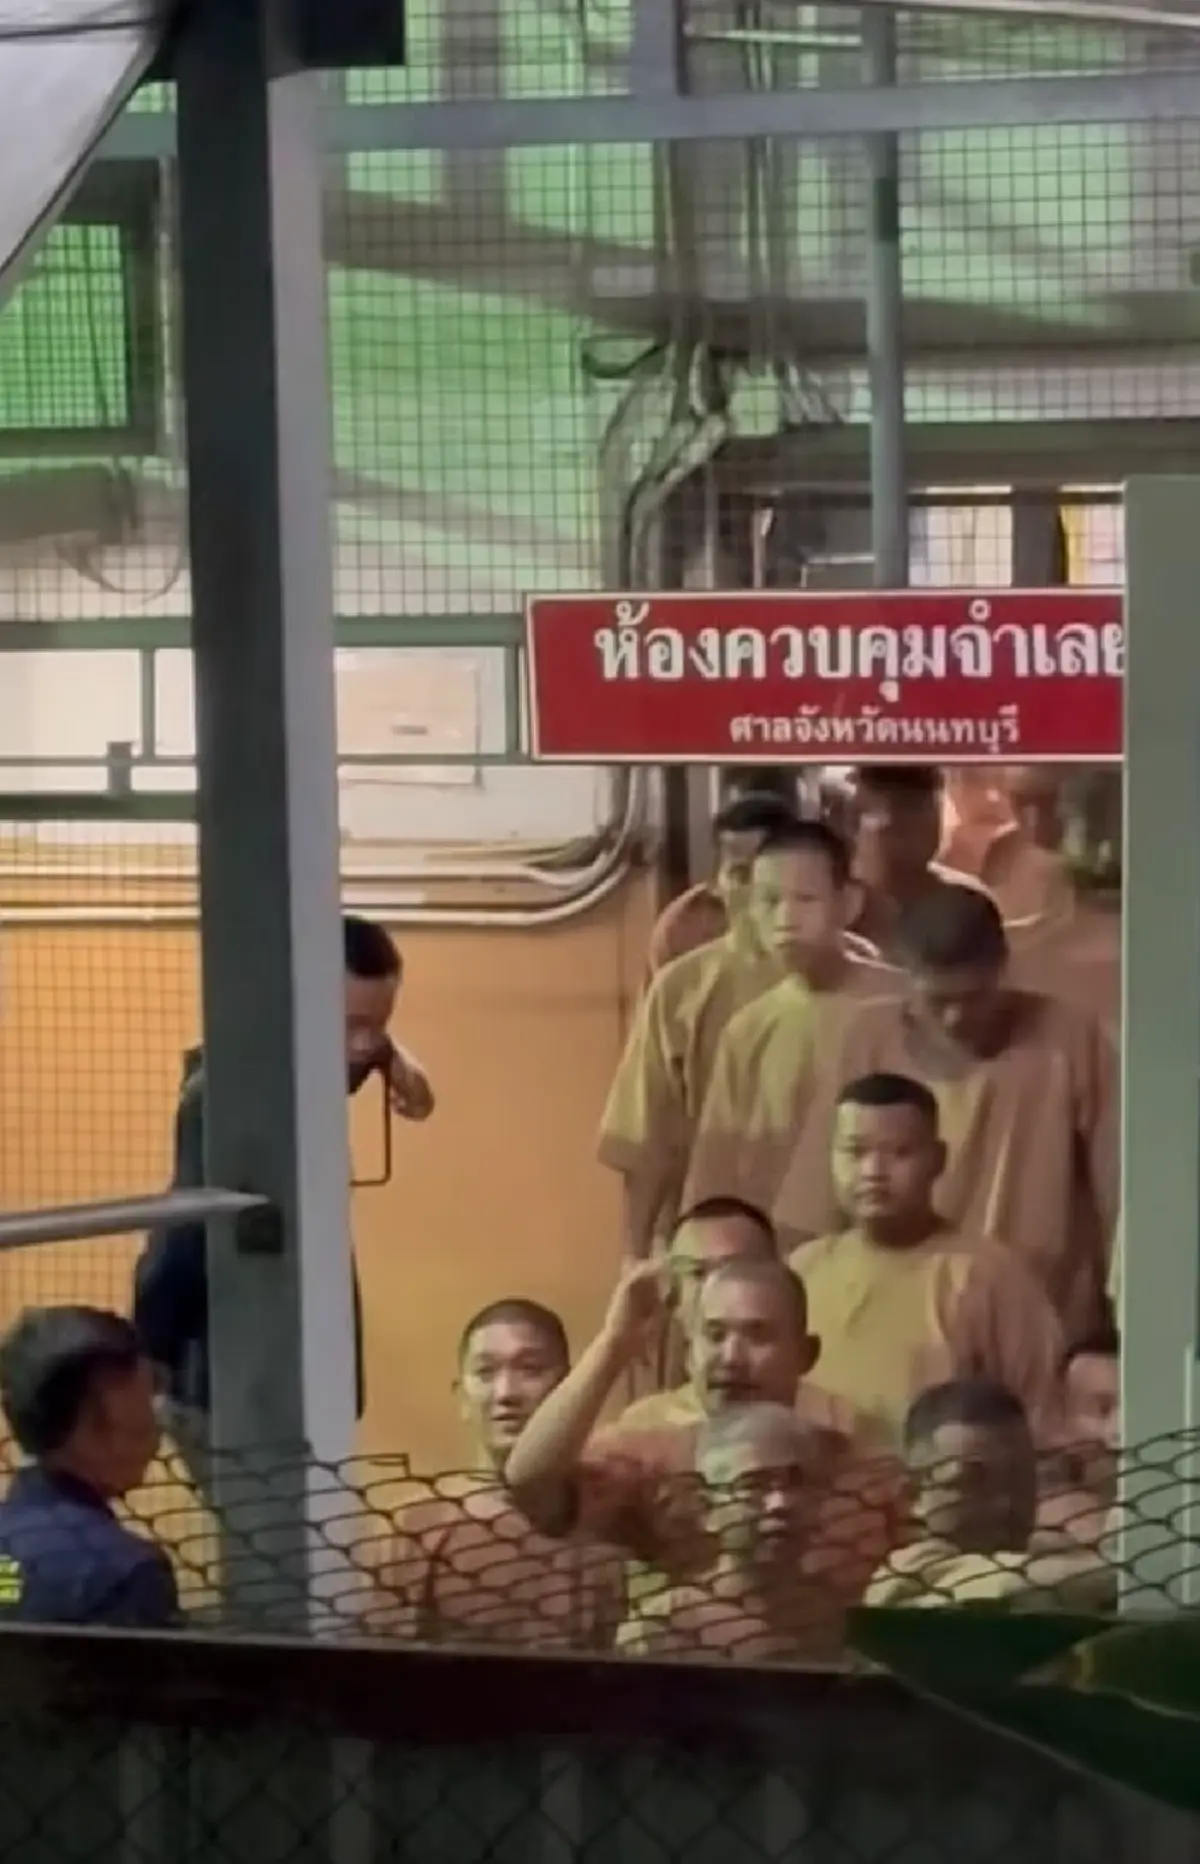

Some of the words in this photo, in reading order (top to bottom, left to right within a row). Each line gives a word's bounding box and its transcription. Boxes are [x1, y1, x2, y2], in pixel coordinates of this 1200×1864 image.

[729, 703, 1020, 754] ศาลจังหวัดนนทบุรี
